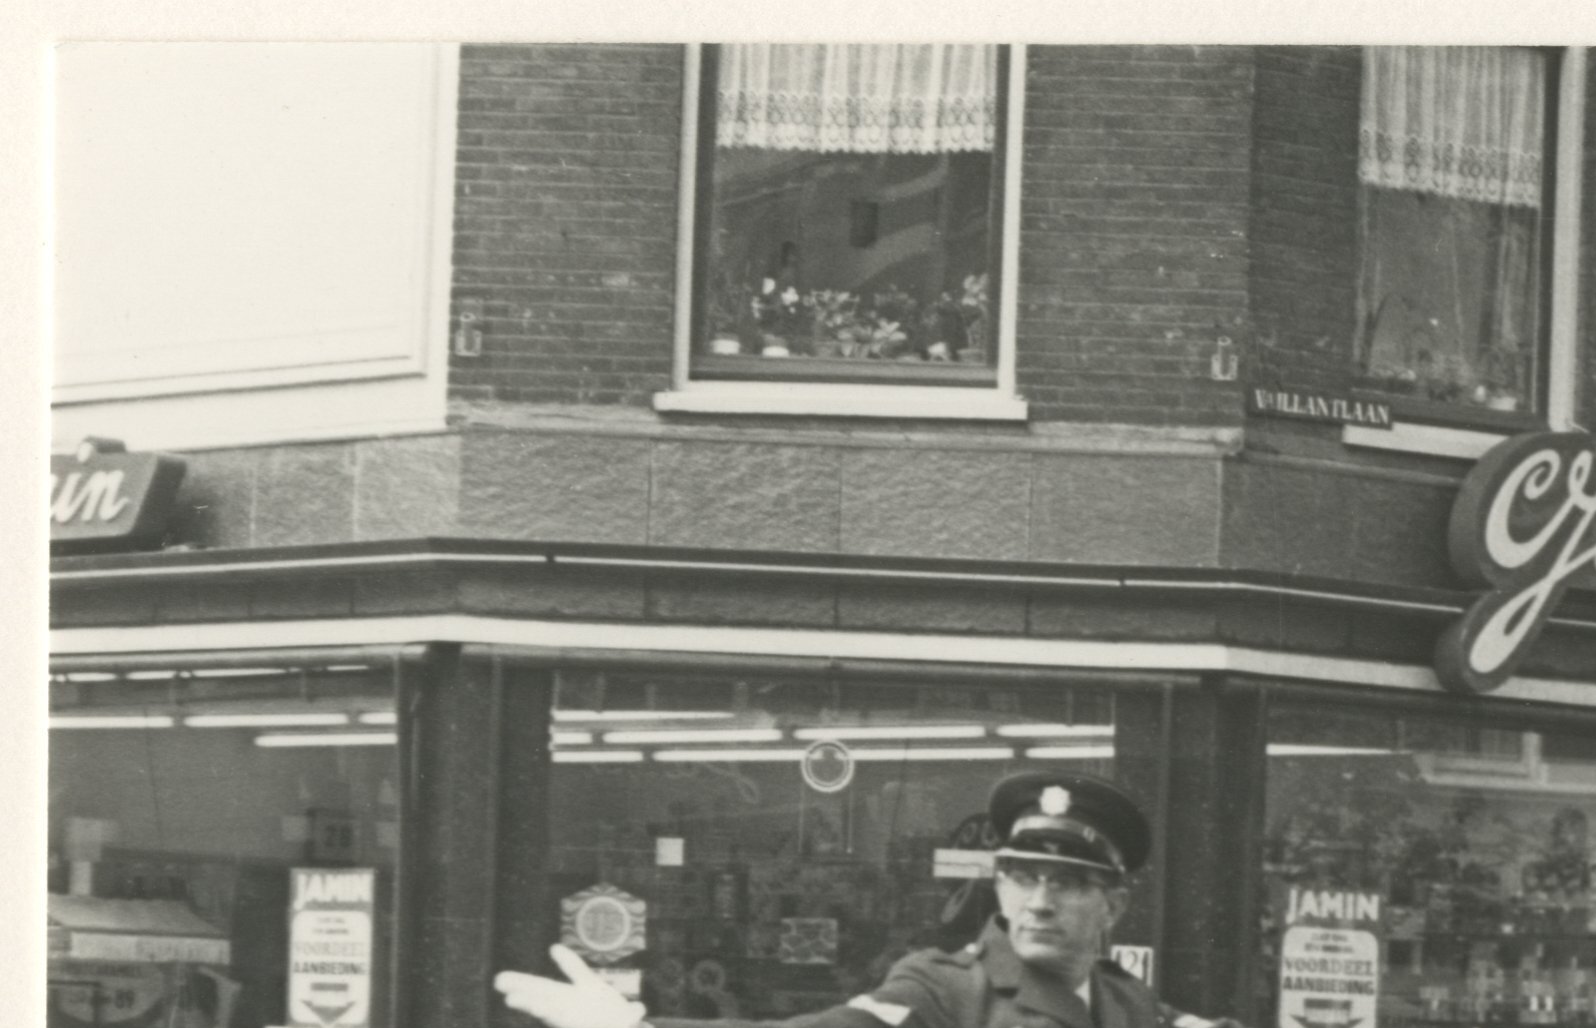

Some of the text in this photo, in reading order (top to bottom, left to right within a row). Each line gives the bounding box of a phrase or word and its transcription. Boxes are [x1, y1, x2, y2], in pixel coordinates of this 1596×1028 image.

[51, 443, 129, 523] in
[294, 873, 373, 910] JAMIN
[1285, 888, 1380, 924] JAMIN
[293, 961, 369, 974] AANBIEDING
[1283, 957, 1374, 976] VOORDEEL
[1282, 975, 1375, 995] AANBIEDING
